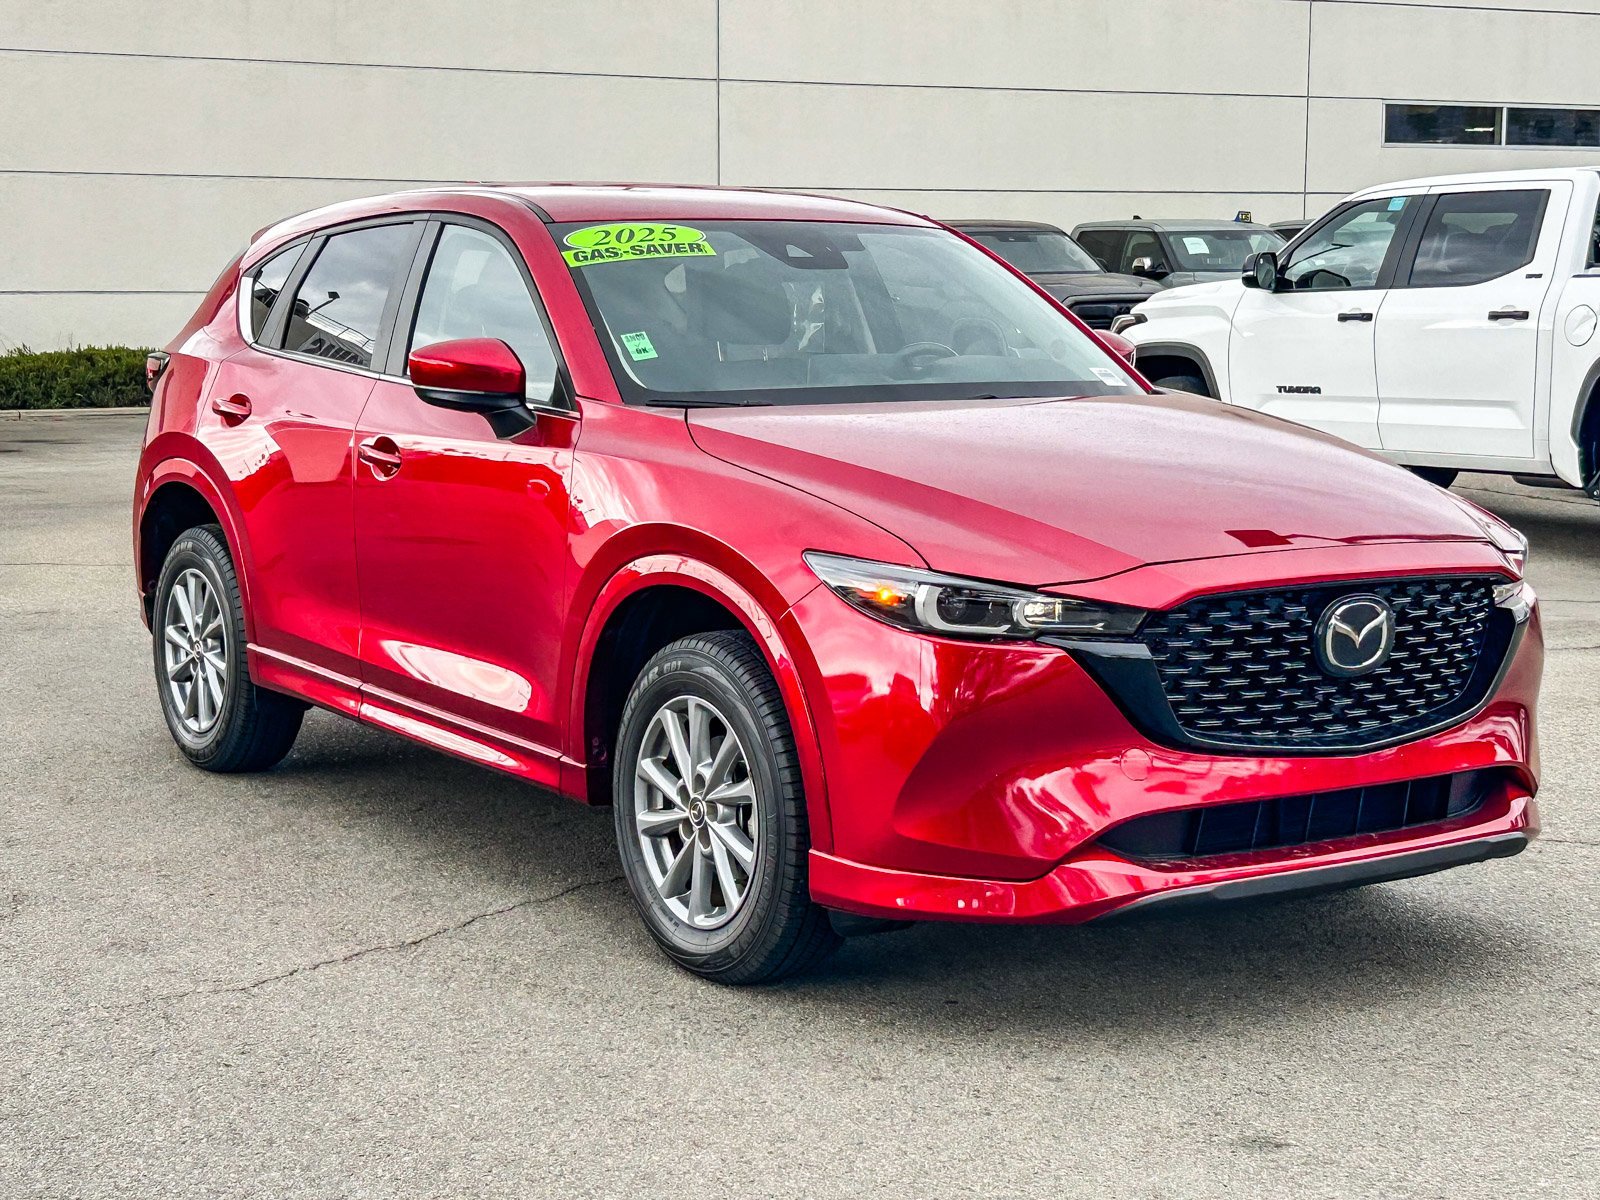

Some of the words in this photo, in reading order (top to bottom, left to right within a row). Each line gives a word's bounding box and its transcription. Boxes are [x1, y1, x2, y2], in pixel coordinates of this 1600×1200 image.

[593, 227, 677, 246] 2025
[573, 242, 704, 263] GAS-SAVER
[1276, 385, 1322, 395] TUNDRA
